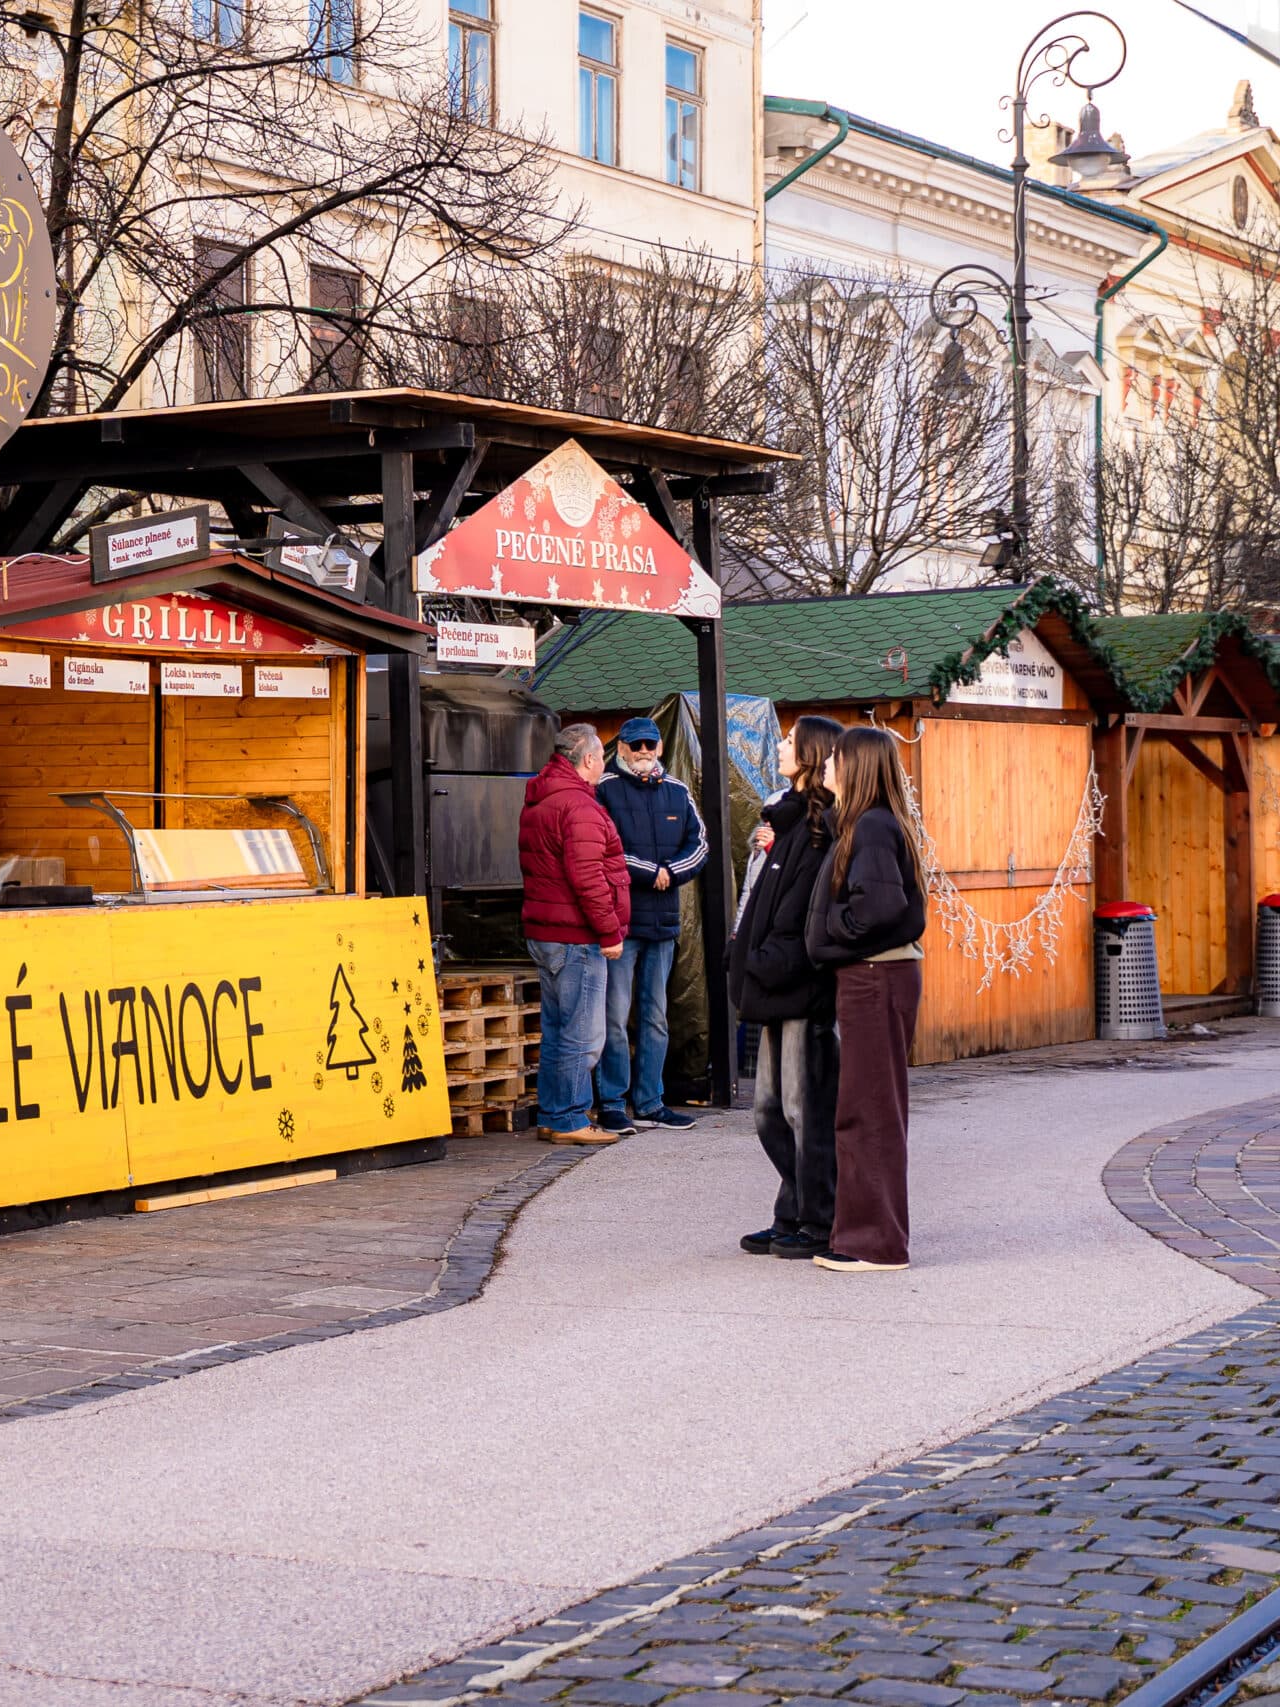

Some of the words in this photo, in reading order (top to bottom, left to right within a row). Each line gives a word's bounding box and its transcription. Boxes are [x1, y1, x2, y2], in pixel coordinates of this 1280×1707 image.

[145, 528, 171, 547] plnené
[135, 549, 152, 558] orech
[495, 525, 586, 568] PEČENÉ
[591, 541, 658, 576] PRASA
[102, 603, 246, 645] GRILLL
[441, 626, 473, 641] Pečené
[474, 631, 499, 645] prasa
[512, 647, 527, 659] 9,50
[68, 661, 104, 675] Cigánska
[165, 667, 187, 679] Lokša
[1010, 662, 1036, 676] VARENÉ
[1037, 662, 1055, 678] VÍNO
[29, 674, 42, 686] 5,50
[68, 676, 75, 684] do
[129, 681, 141, 692] 7,50
[59, 975, 272, 1113] VIANOCE
